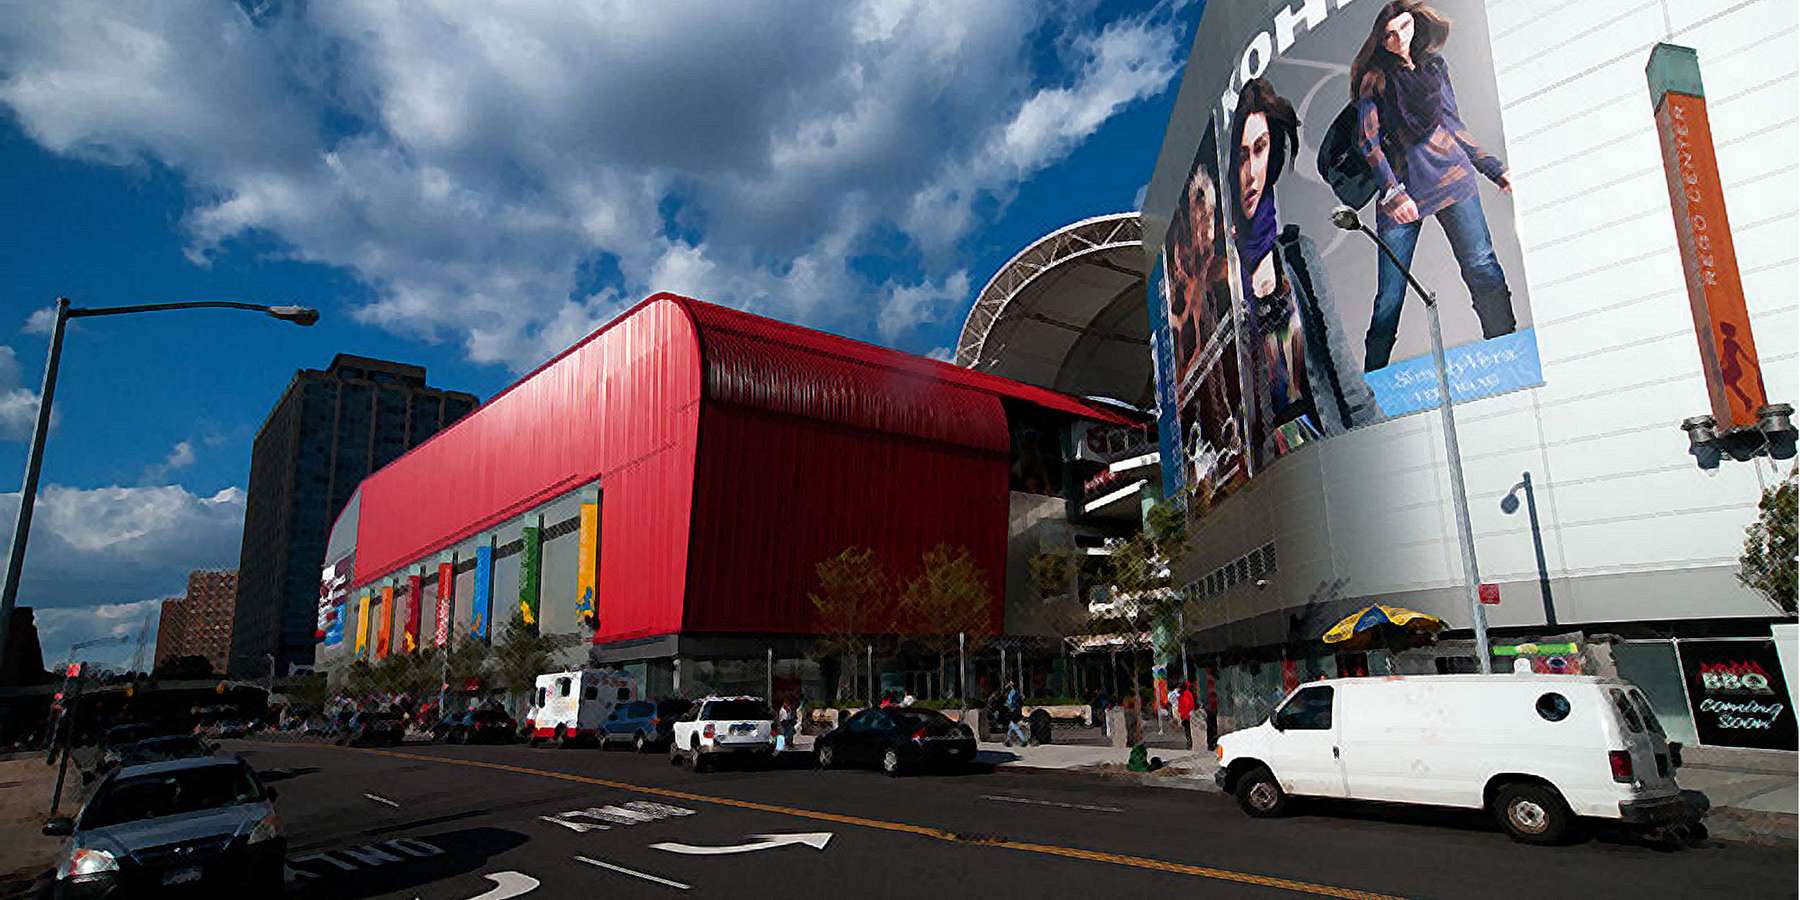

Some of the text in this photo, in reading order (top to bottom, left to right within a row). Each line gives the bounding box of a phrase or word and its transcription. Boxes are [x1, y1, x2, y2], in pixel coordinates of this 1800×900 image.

[1222, 0, 1353, 130] KOH
[1673, 104, 1717, 285] REGO CENTER
[1702, 671, 1775, 695] BBQ
